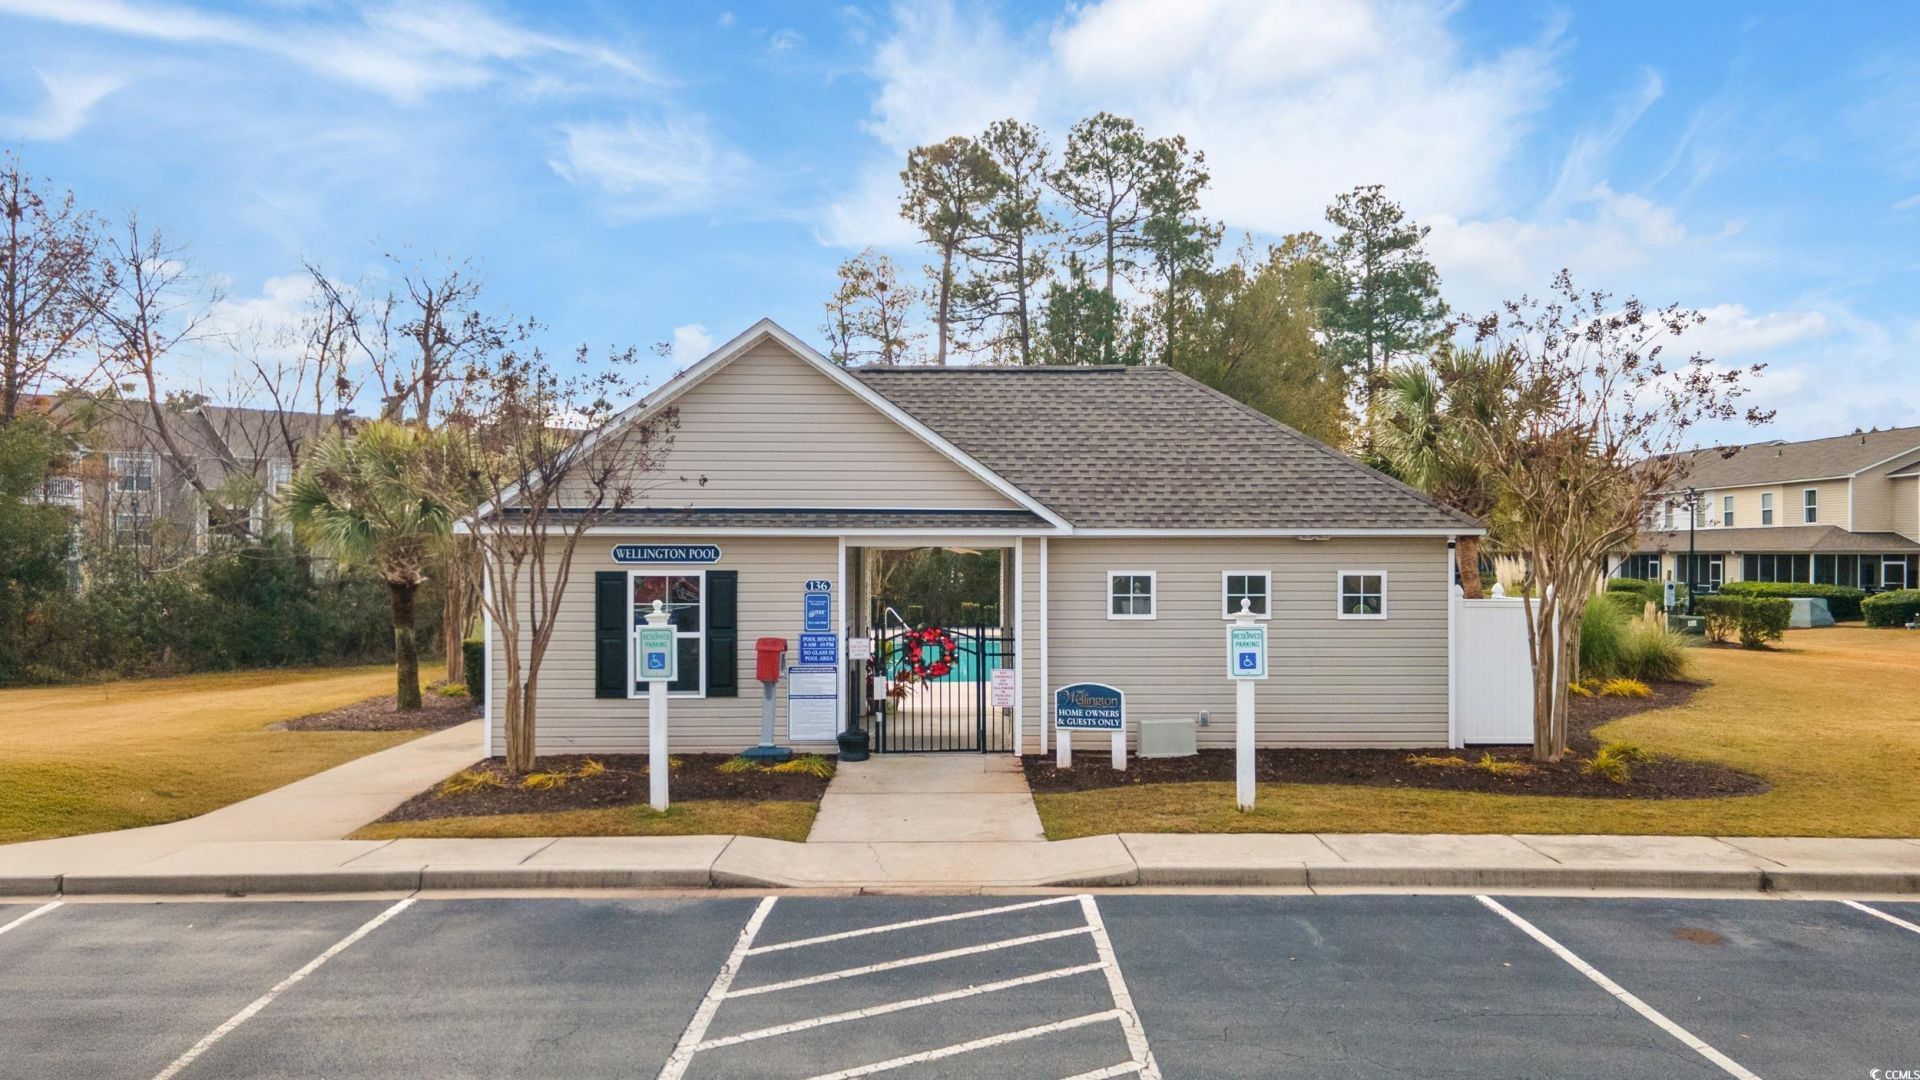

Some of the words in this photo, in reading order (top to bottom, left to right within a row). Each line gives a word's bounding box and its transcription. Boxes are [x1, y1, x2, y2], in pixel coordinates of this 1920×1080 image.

[615, 548, 686, 559] WELLINGTON
[689, 548, 718, 559] POOL
[809, 581, 828, 591] 136
[1233, 632, 1261, 640] RESERVED
[1058, 709, 1083, 717] HOME
[1085, 709, 1119, 718] OWNERS
[1066, 718, 1096, 726] GUESTS
[1097, 718, 1120, 727] ONLY
